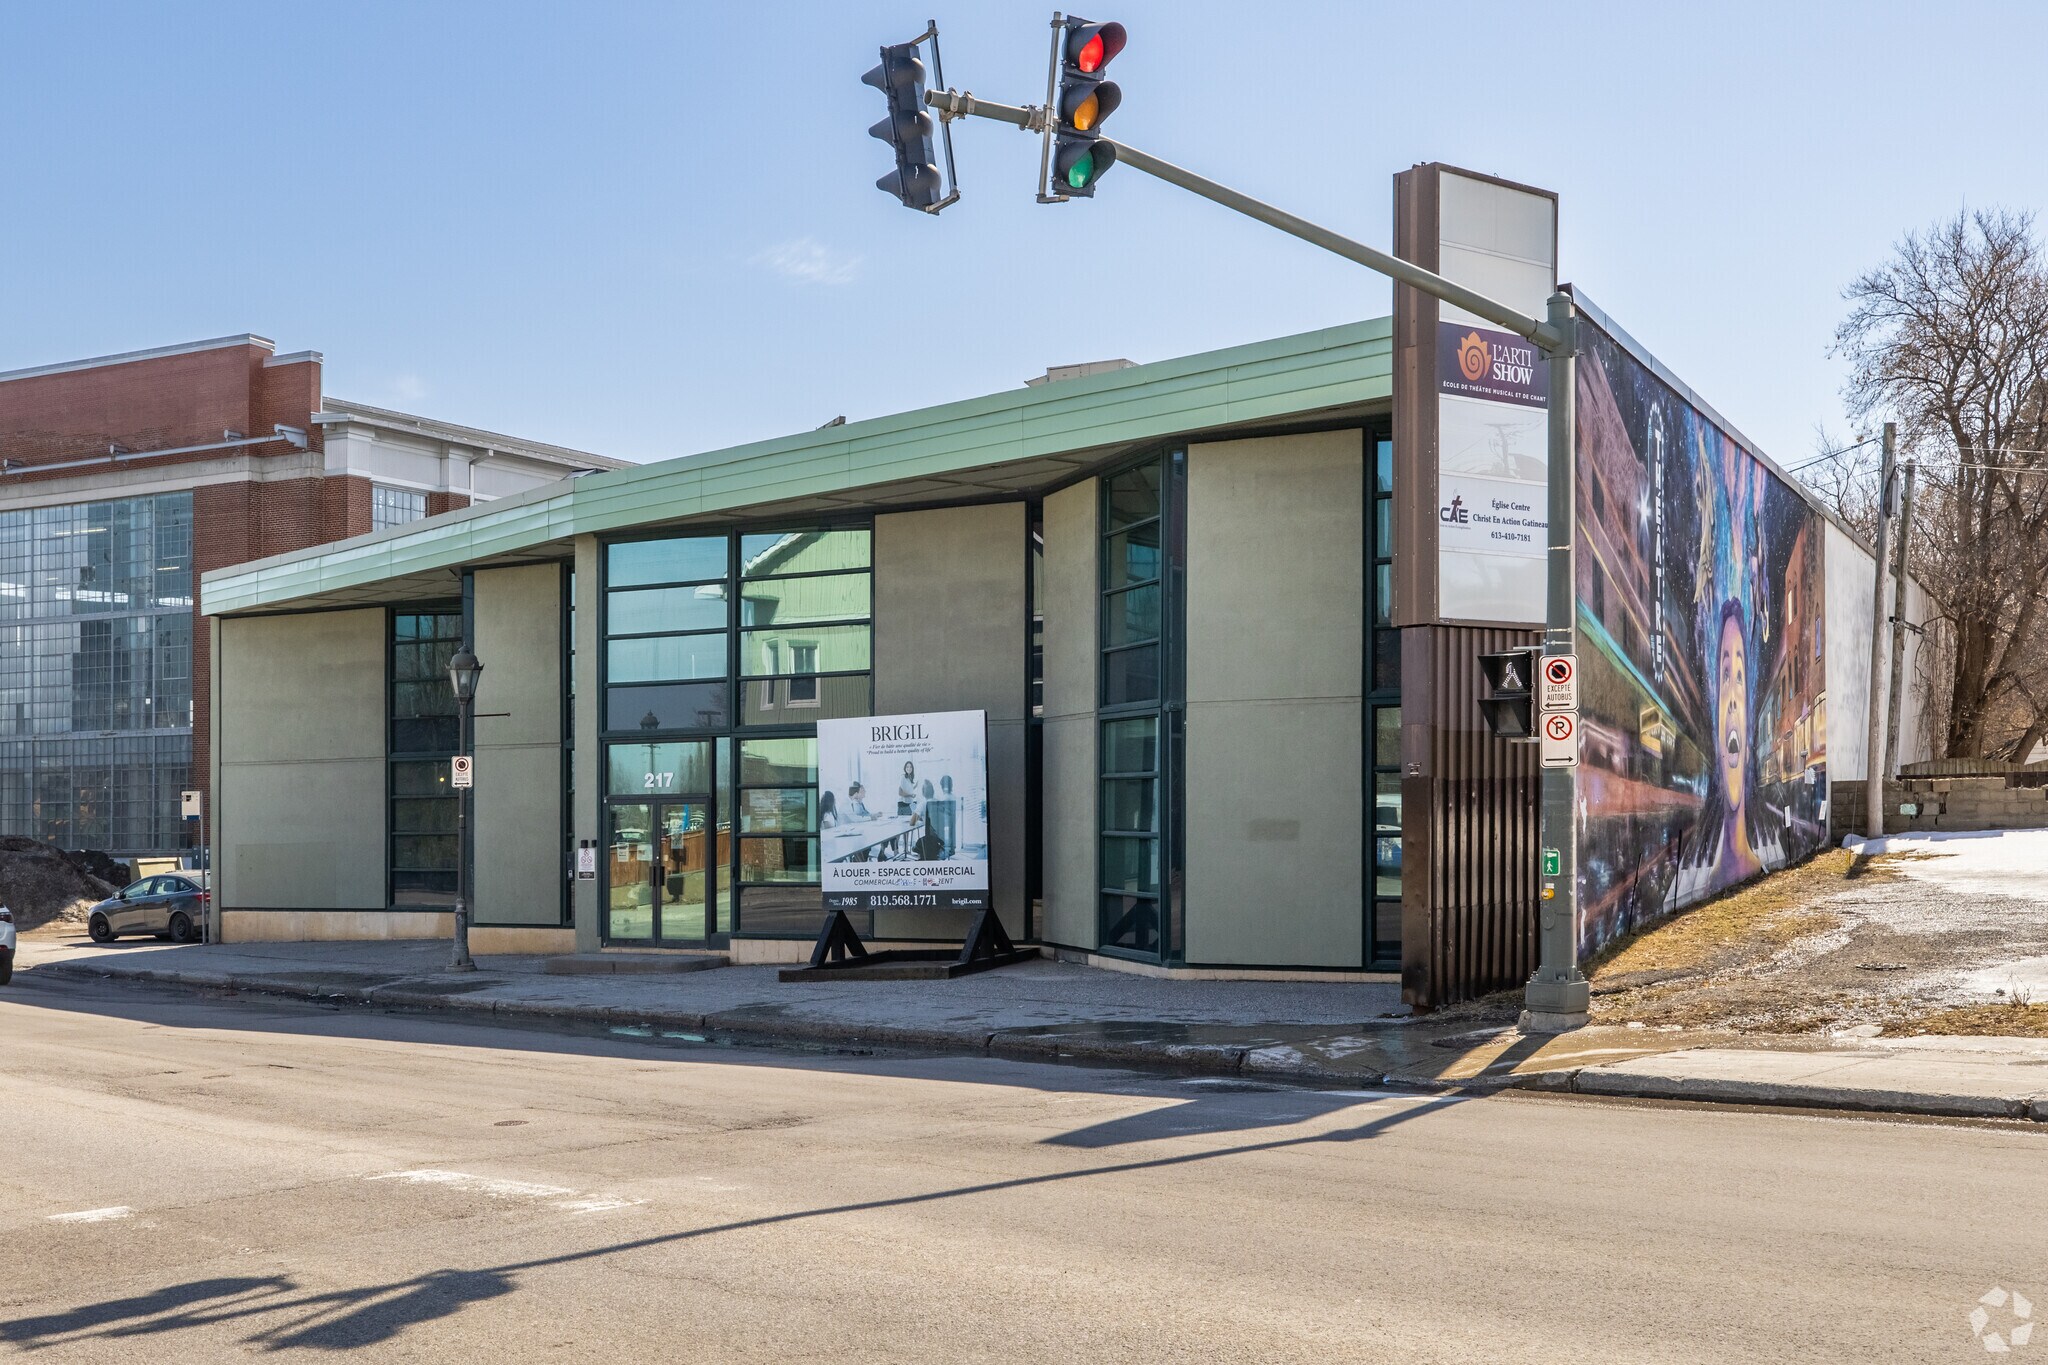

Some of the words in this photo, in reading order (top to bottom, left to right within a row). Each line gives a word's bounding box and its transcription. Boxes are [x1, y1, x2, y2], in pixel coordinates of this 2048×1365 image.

[1493, 363, 1533, 385] SHOW
[1443, 380, 1460, 389] ÉCOLE
[1469, 385, 1491, 394] THÉÂTRE
[1493, 388, 1514, 397] MUSICAL
[1492, 498, 1509, 510] Église
[1510, 502, 1530, 511] Centre
[1473, 514, 1491, 523] Christ
[1502, 517, 1521, 525] Action
[1522, 519, 1548, 528] Gatineau
[1491, 531, 1531, 542] 613-410-7181
[1548, 684, 1571, 692] EXCEPTÉ
[1547, 693, 1572, 701] AUTOBUS
[872, 724, 929, 741] BRIGIL
[644, 772, 674, 788] 217
[833, 868, 839, 877] À
[841, 868, 870, 877] LOUER
[879, 868, 910, 876] ESPACE
[913, 866, 975, 876] COMMERCIAL
[842, 897, 858, 906] 1985
[870, 895, 936, 906] 819.568.1771
